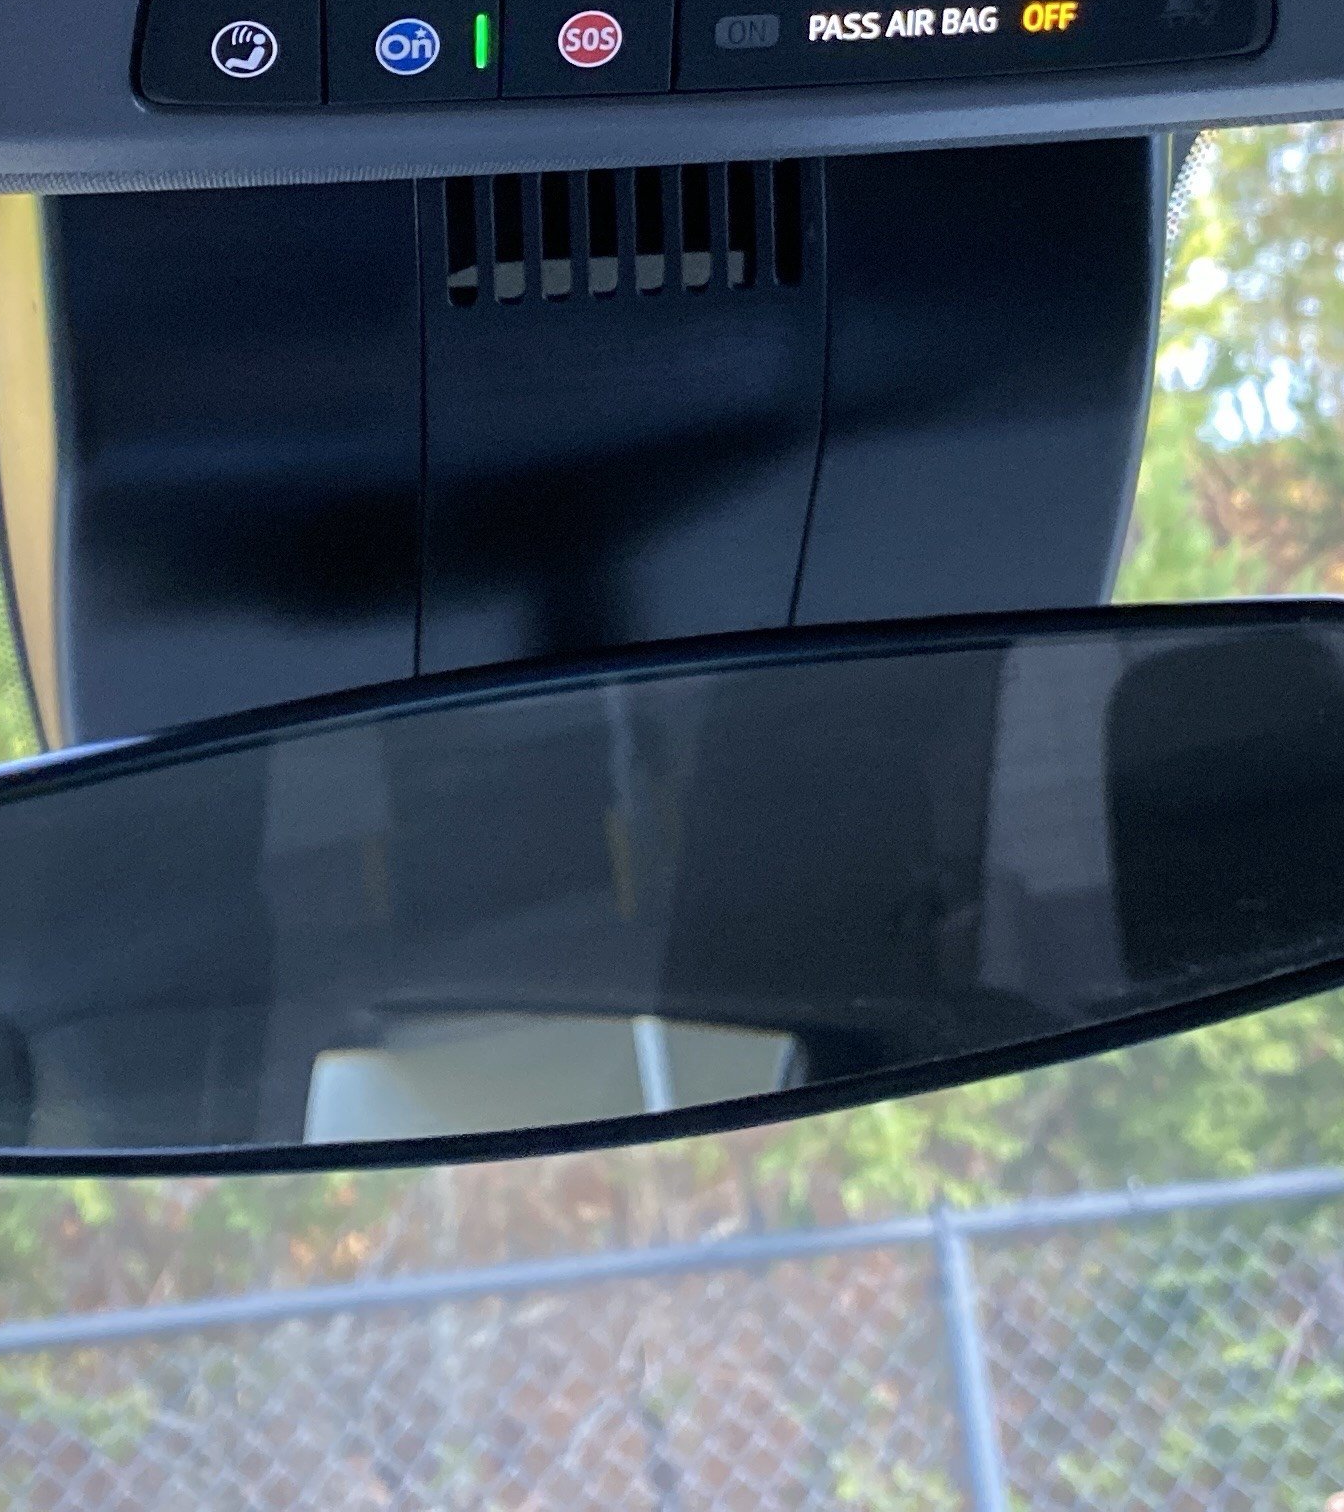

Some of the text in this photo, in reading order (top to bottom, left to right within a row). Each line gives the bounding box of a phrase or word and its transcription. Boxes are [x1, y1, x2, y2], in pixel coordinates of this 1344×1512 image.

[728, 0, 1078, 43] ON PASS AIR BAG OFF
[381, 33, 434, 62] On
[565, 27, 616, 52] SOS
